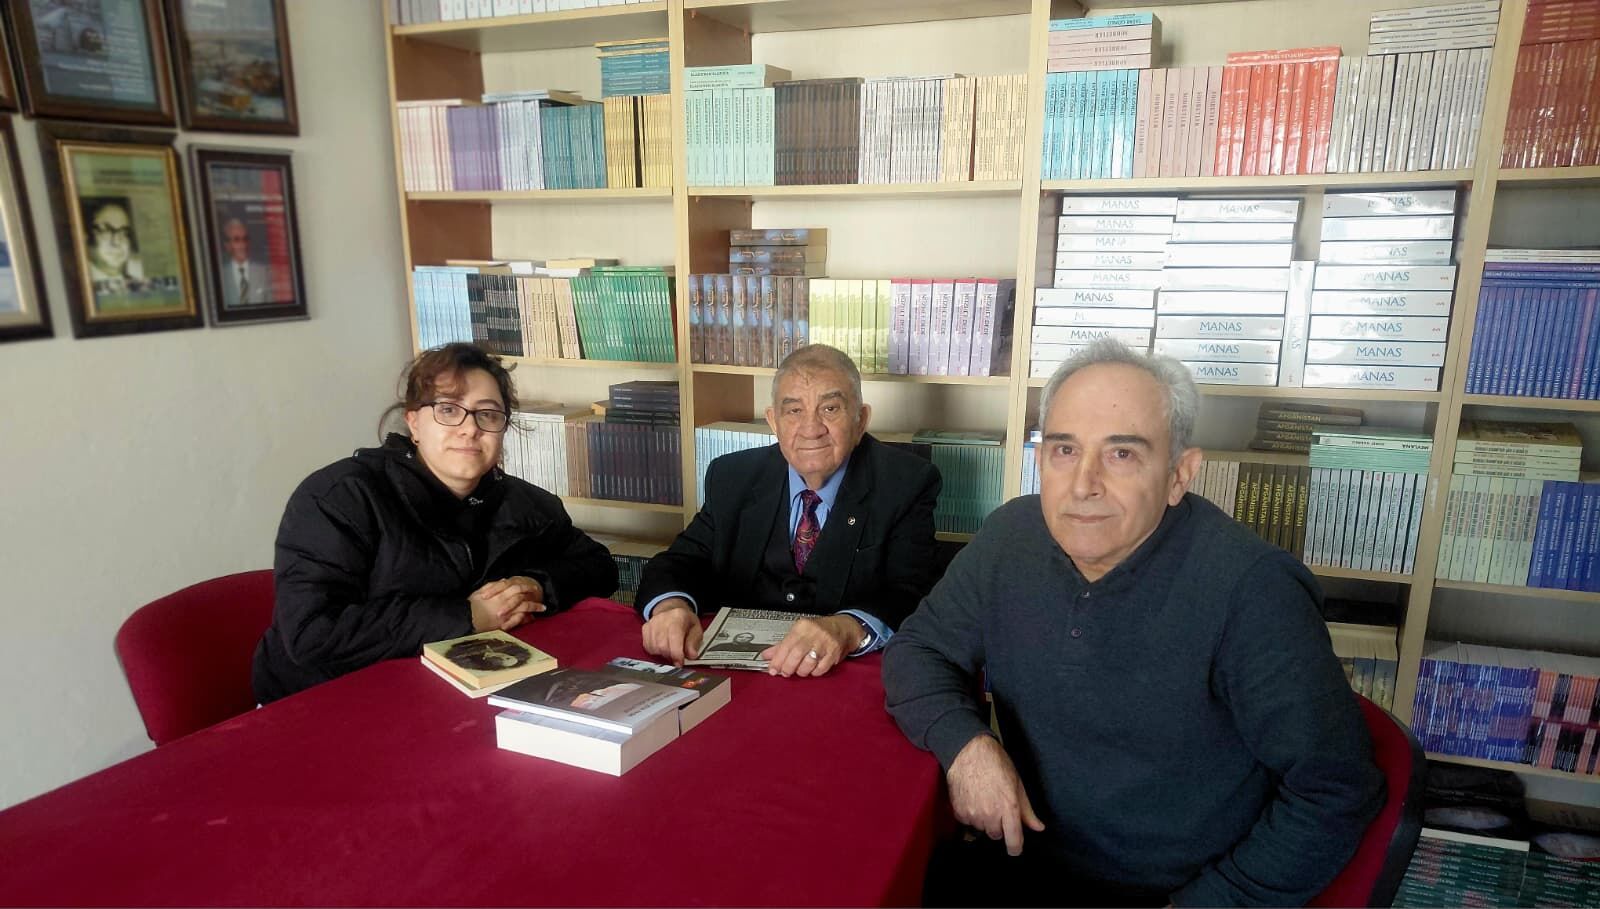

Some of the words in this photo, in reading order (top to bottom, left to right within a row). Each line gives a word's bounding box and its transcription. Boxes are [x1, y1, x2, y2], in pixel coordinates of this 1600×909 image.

[1102, 200, 1140, 209] MANAS
[1363, 271, 1410, 281] MANAS
[1074, 292, 1114, 302] MANAS
[1360, 297, 1406, 306] MANAS
[1200, 321, 1242, 331] MANAS
[1356, 323, 1402, 332] MANAS
[1198, 344, 1240, 354] MANAS
[1356, 347, 1402, 357] MANAS
[1196, 367, 1238, 377] MANAS
